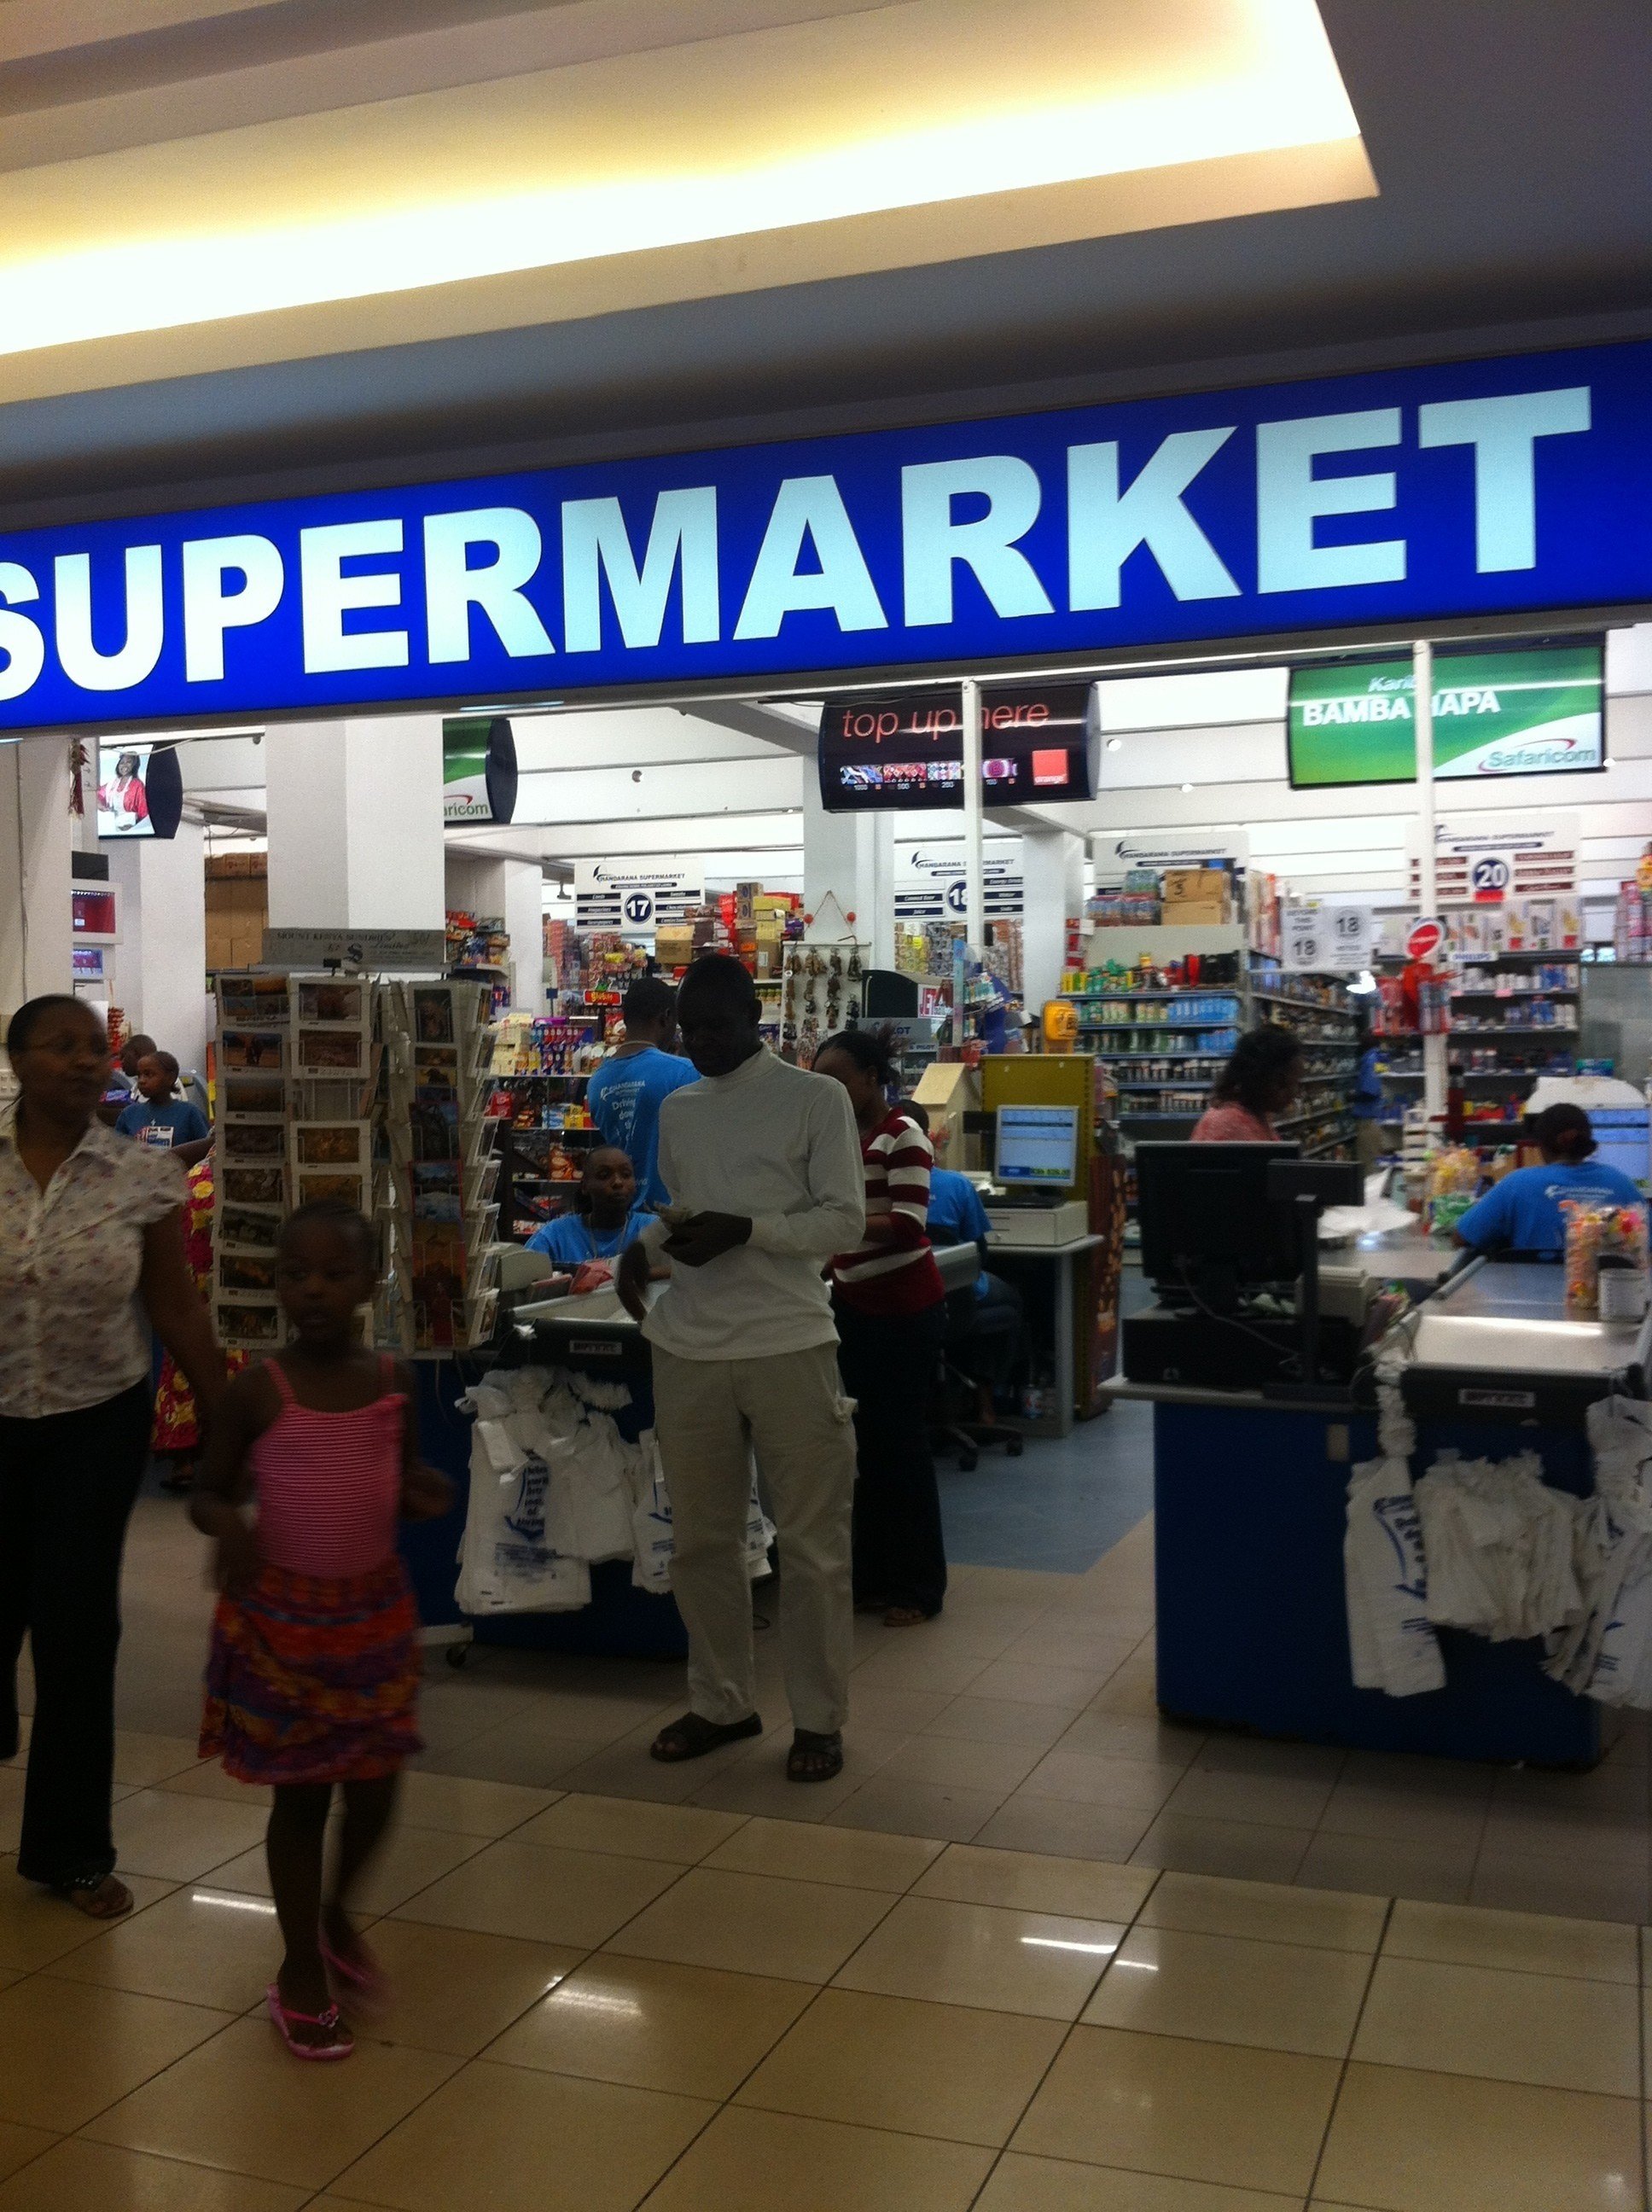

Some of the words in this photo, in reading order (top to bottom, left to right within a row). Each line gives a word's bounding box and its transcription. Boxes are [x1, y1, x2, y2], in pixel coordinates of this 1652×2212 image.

[1303, 696, 1411, 726] BAMBA
[842, 710, 898, 743] top
[912, 708, 956, 741] up
[1487, 746, 1597, 768] Safaricom
[1477, 864, 1505, 888] 20
[627, 899, 649, 917] 17
[1336, 917, 1359, 933] 18
[1293, 940, 1318, 956] 18
